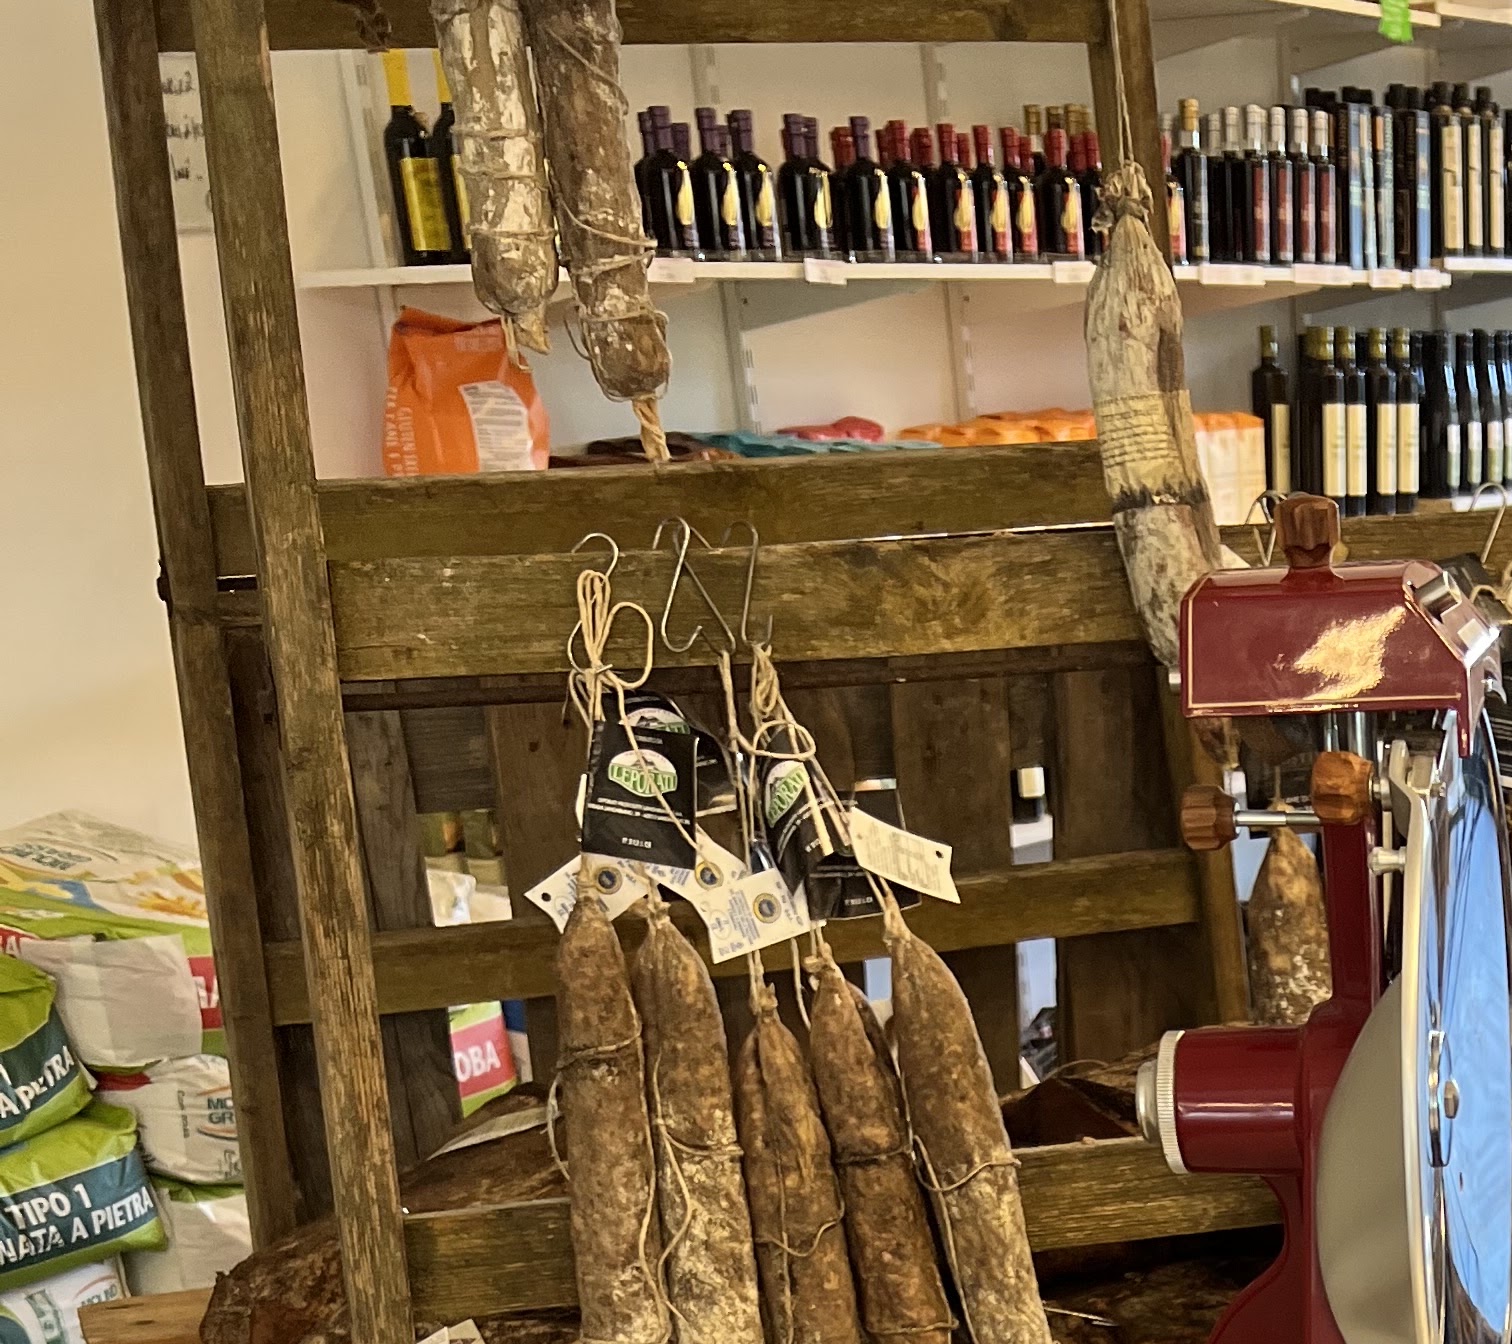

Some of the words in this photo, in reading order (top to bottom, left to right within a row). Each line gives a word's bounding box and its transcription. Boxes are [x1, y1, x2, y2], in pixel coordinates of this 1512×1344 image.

[4, 1192, 71, 1230] TIPO
[73, 1183, 92, 1208] 1
[71, 1216, 89, 1243] A
[91, 1186, 154, 1236] PIETRA
